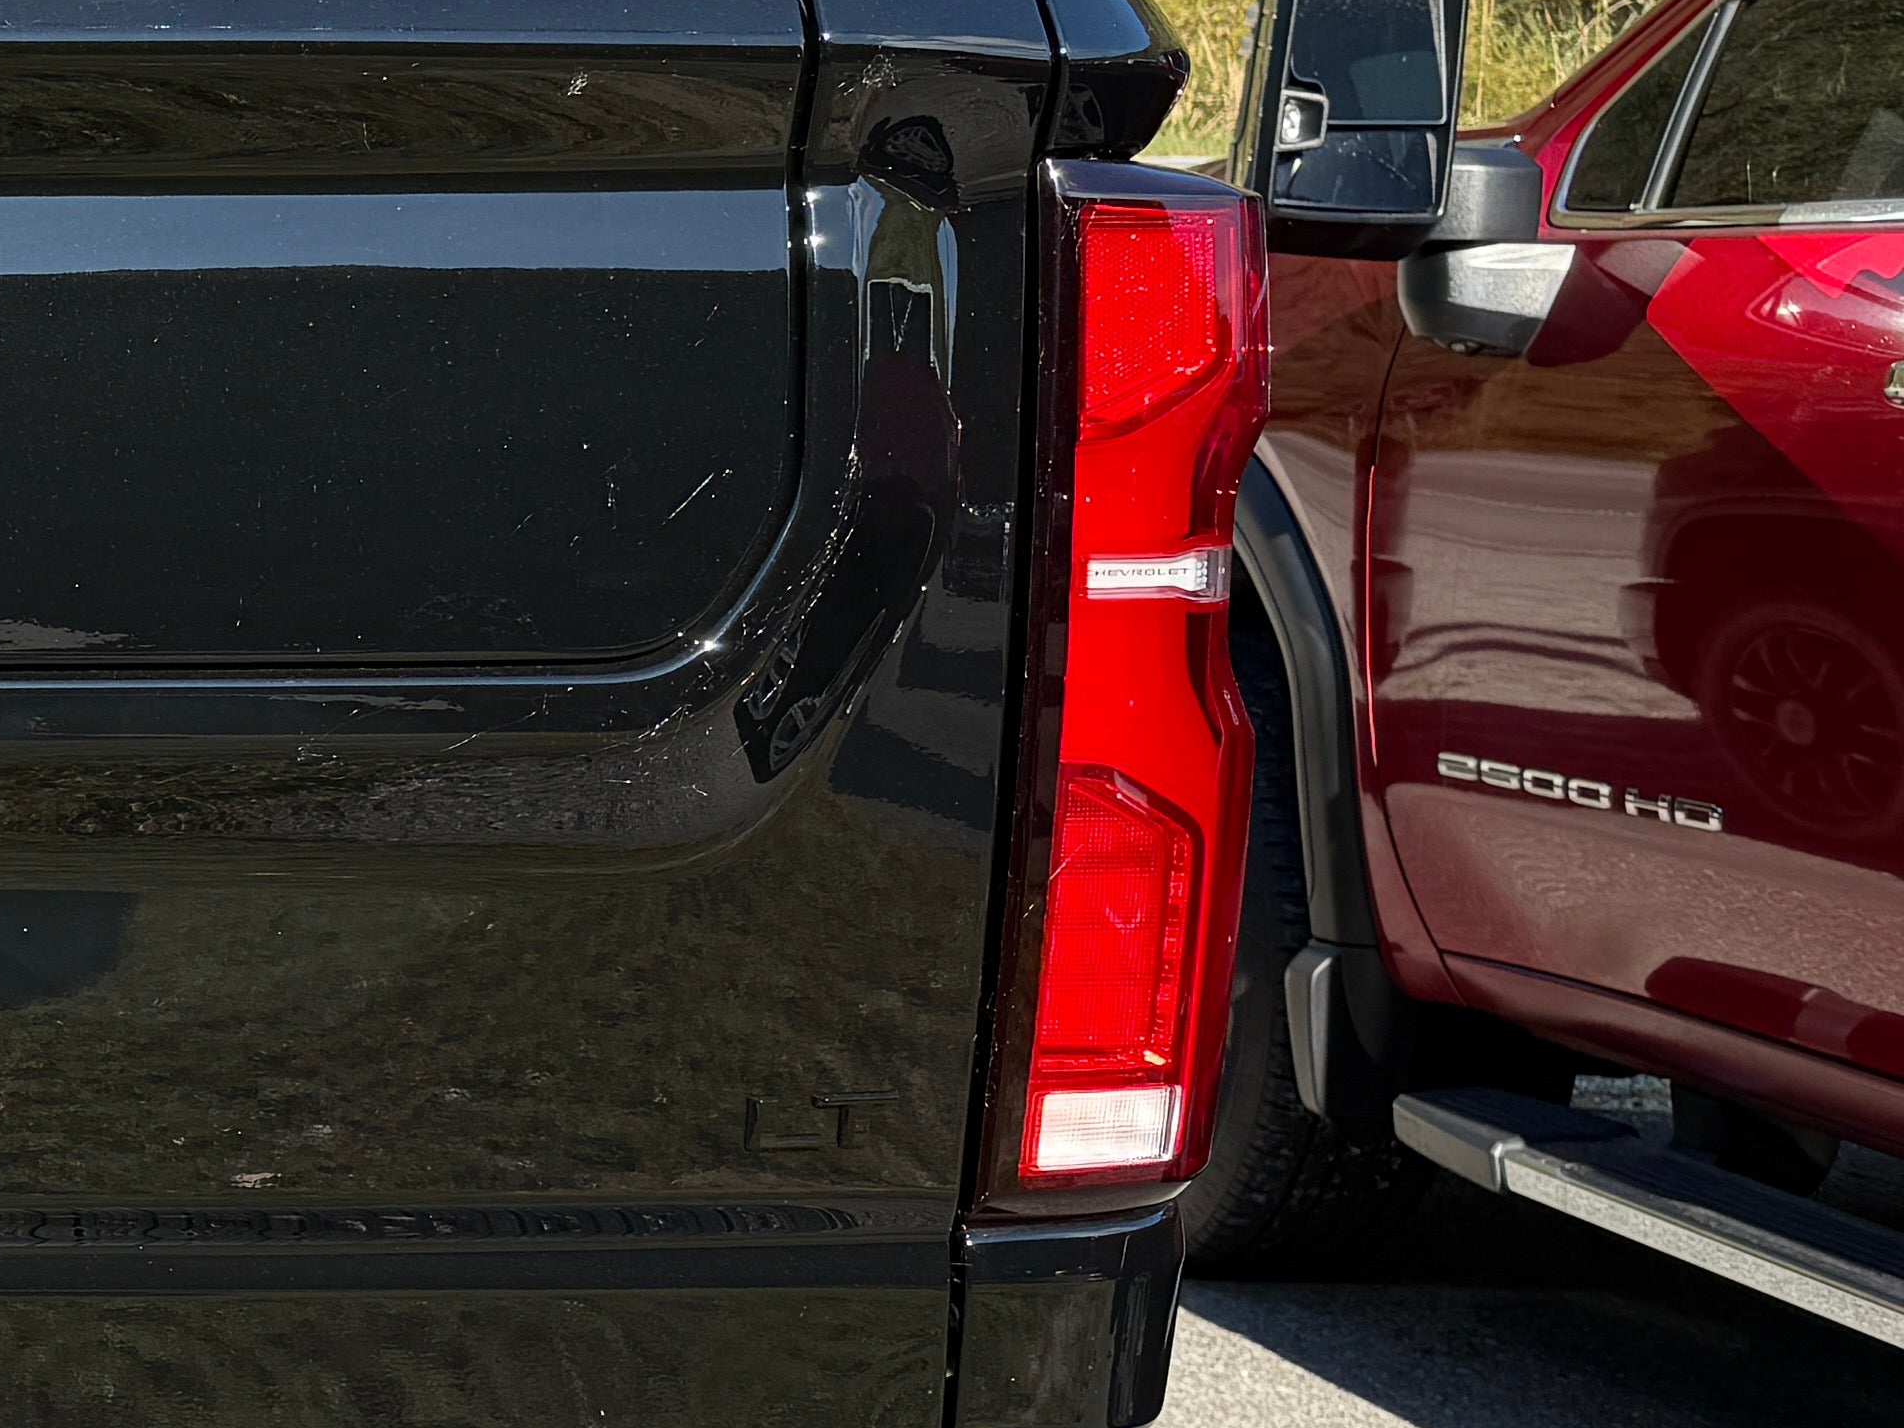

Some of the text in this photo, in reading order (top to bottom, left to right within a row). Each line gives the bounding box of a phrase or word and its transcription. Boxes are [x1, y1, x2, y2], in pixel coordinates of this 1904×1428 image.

[1437, 752, 1723, 832] 2500 HD
[744, 1089, 900, 1152] LT
